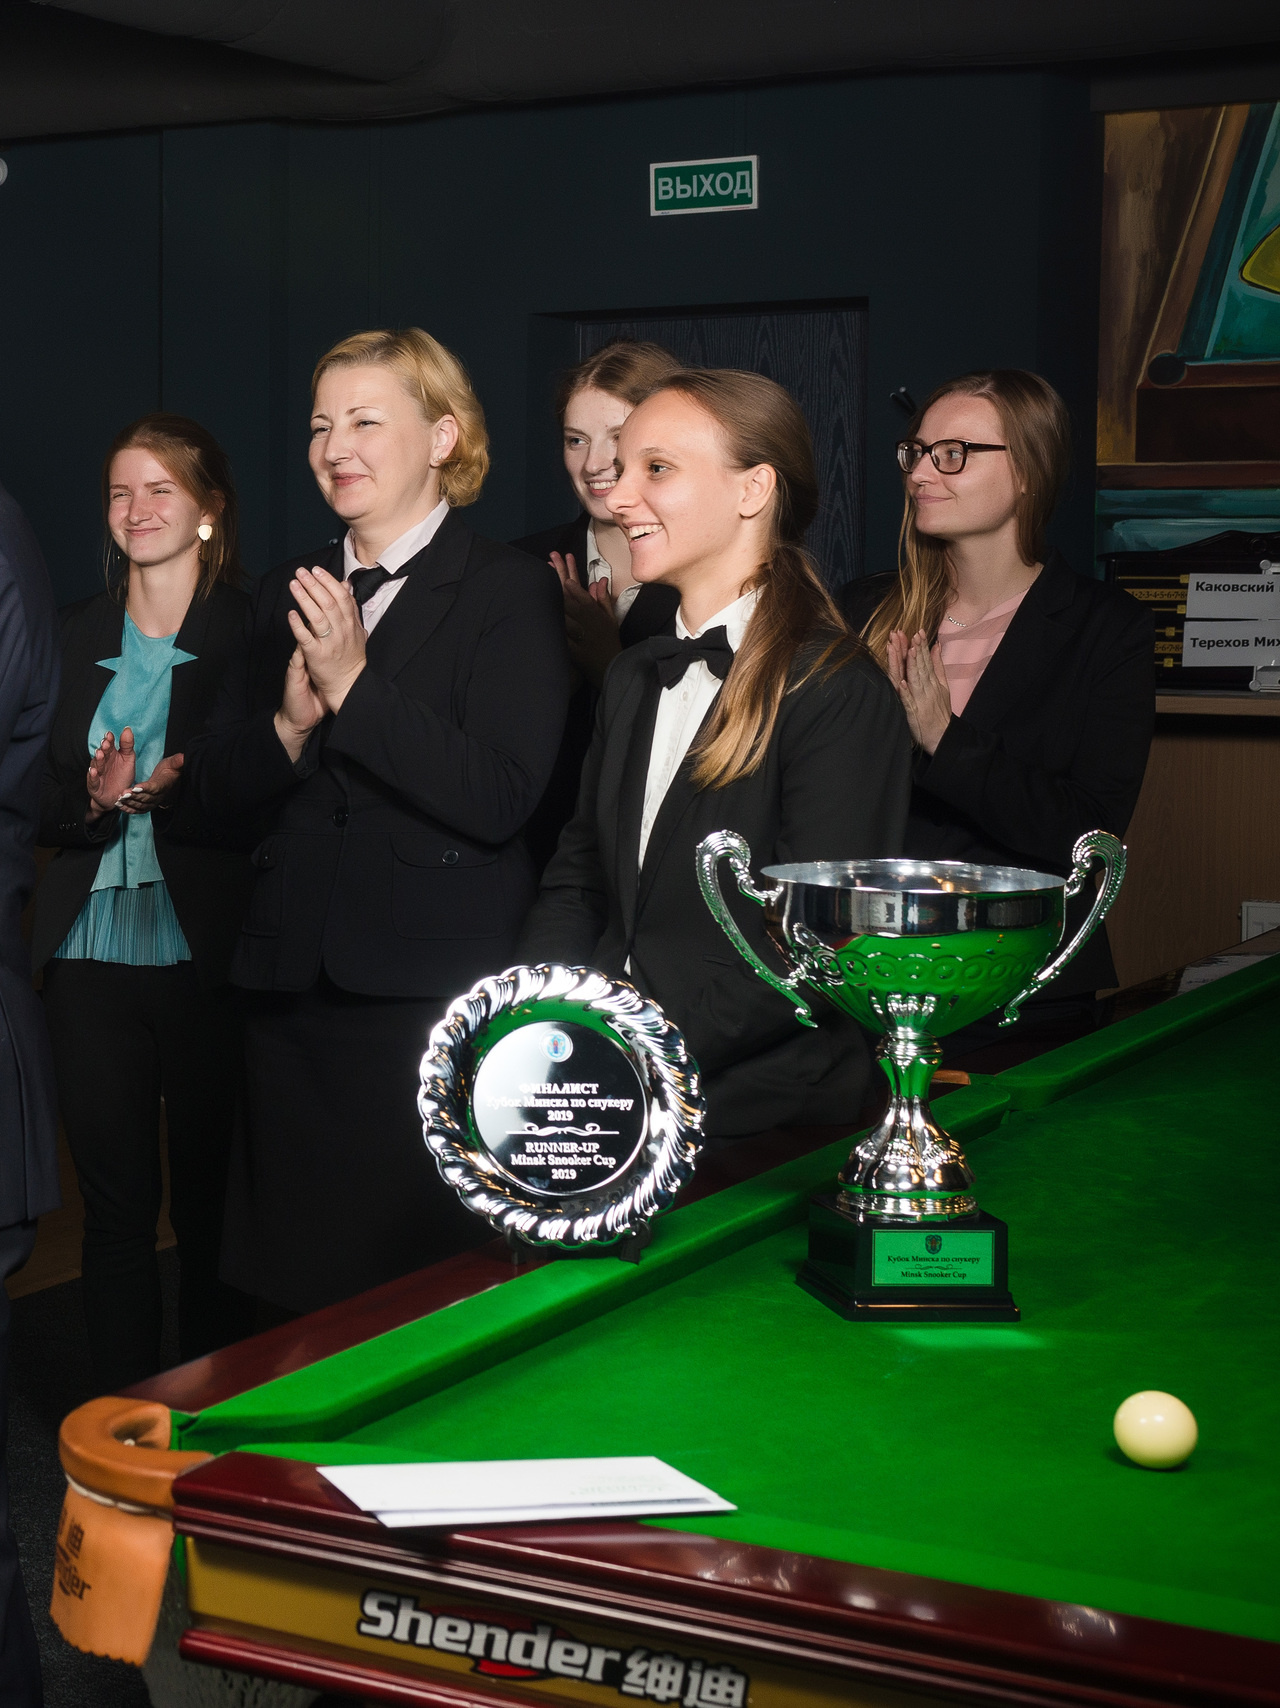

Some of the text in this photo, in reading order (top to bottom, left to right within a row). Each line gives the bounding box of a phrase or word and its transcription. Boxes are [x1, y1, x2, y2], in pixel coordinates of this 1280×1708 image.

[658, 171, 751, 200] ВЫХОД
[1195, 581, 1274, 592] Каковский
[1190, 638, 1249, 650] Терехов
[518, 1083, 599, 1094] ФИНАЛИСТ
[523, 1096, 569, 1108] Минска
[570, 1098, 587, 1108] по
[587, 1098, 634, 1111] снукеру
[547, 1110, 574, 1121] 2019
[525, 1142, 600, 1153] RUNNER-UP
[510, 1154, 616, 1168] Minsk Snooker Cup
[551, 1168, 577, 1179] 2019
[887, 1255, 910, 1264] Кубок
[952, 1271, 967, 1279] Cup
[358, 1590, 748, 1707] Shender 绅迪
